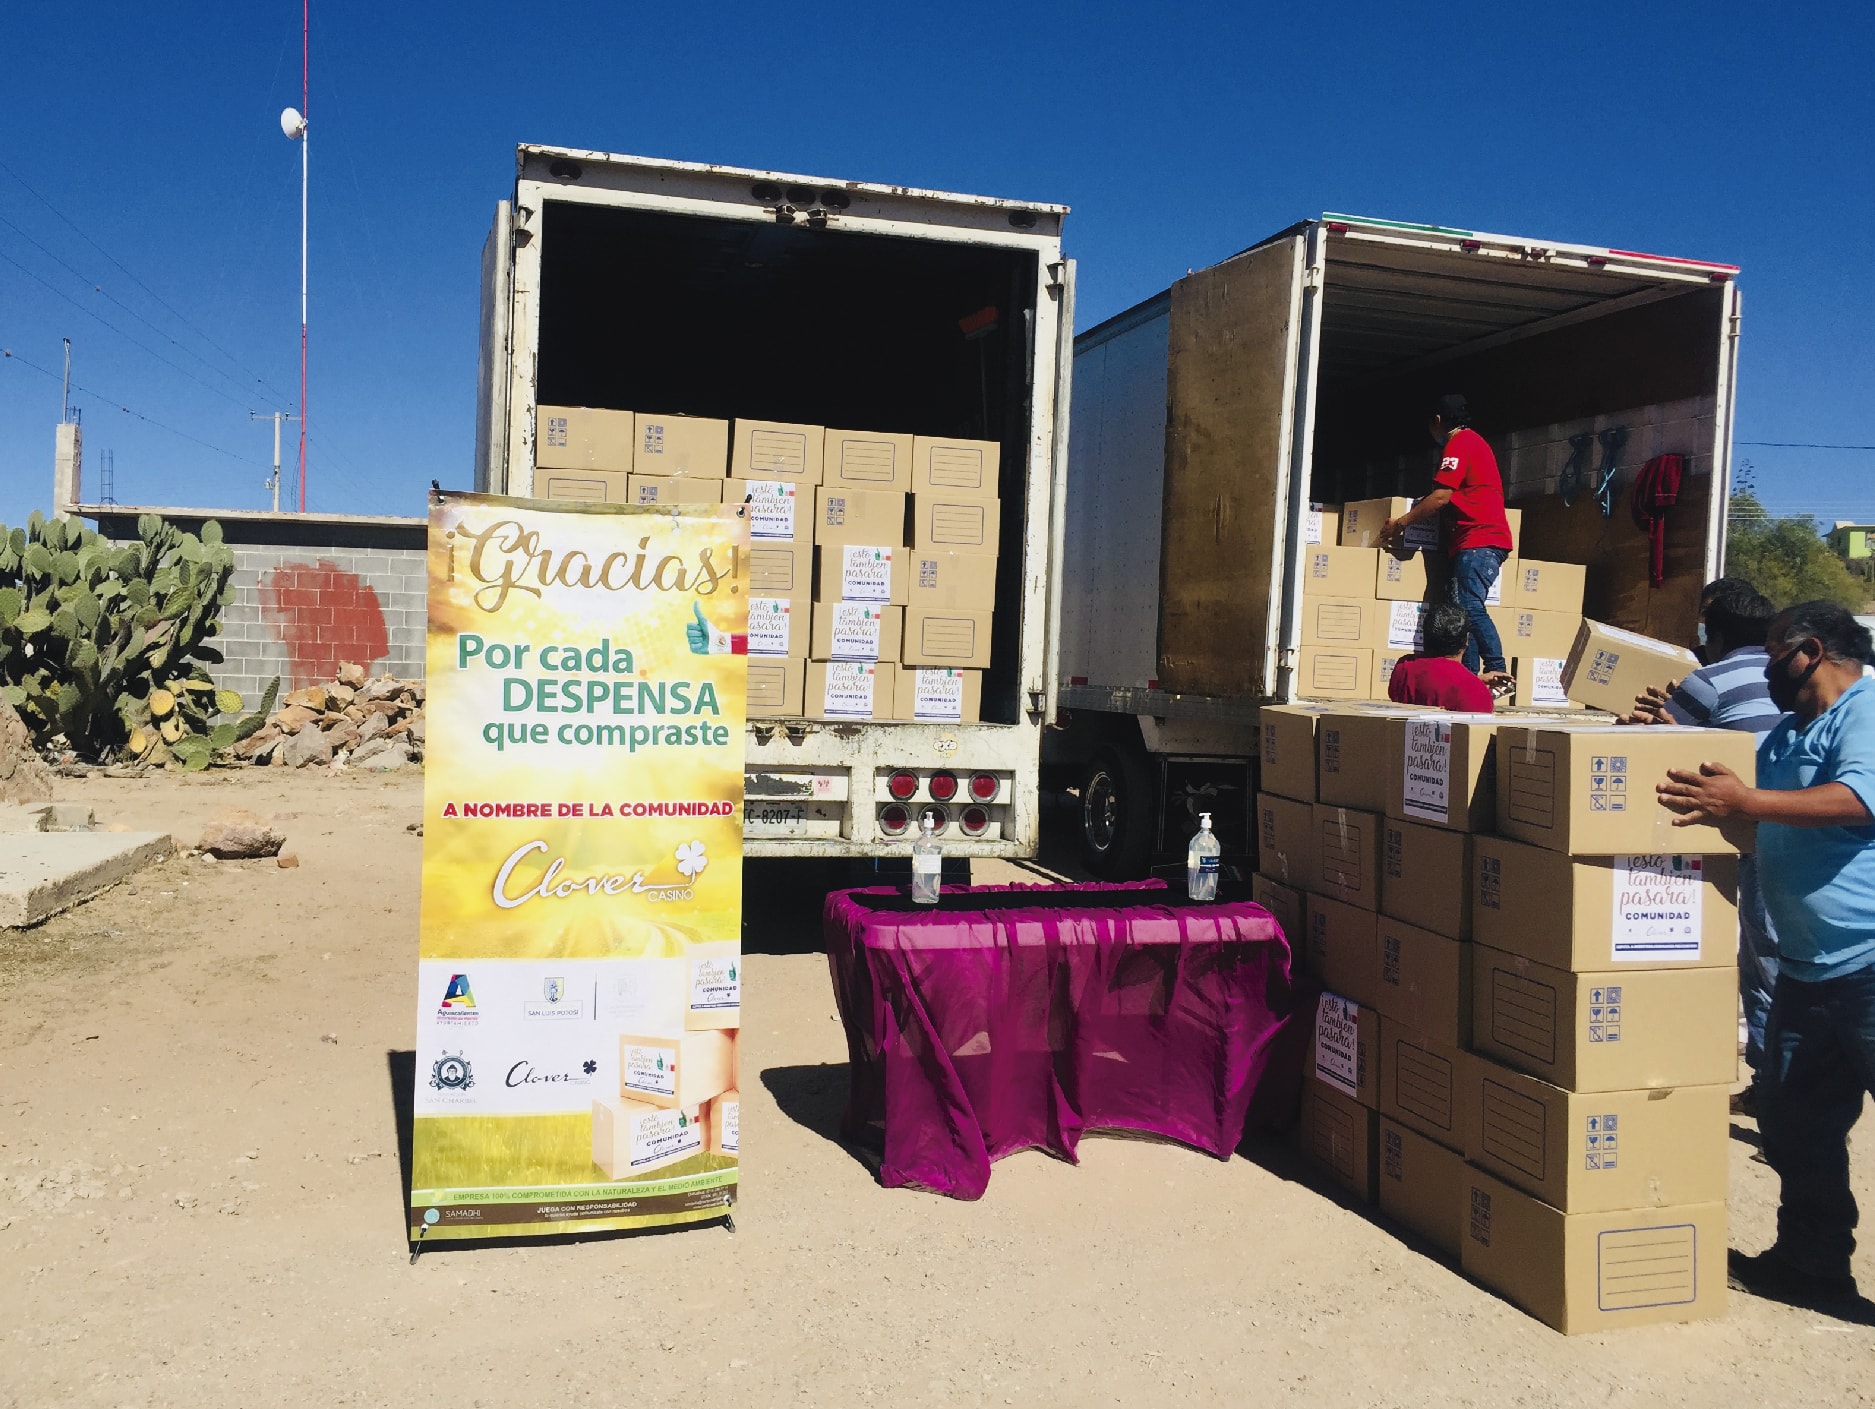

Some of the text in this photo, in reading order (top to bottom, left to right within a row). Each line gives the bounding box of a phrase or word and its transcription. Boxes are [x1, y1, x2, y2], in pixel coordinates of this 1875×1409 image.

[1440, 457, 1459, 469] 23
[447, 520, 739, 613] ¡Gracias!
[458, 634, 634, 674] Por cada
[503, 678, 720, 716] DESPENSA
[483, 721, 729, 753] que compraste
[1410, 773, 1443, 786] COMUNIDAD
[443, 801, 733, 818] A NOMBRE DE LA COMUNIDAD
[493, 840, 647, 909] Clover
[648, 888, 694, 902] CASINO
[1625, 912, 1690, 920] COMUNIDAD
[1321, 1042, 1351, 1061] COMUNIDAD
[505, 1060, 569, 1088] Clover
[646, 1130, 689, 1146] COMUNIDAD
[512, 1191, 571, 1199] COMPROMETIDA
[603, 1187, 650, 1195] NATURALEZA
[669, 1182, 690, 1190] MEDIO
[690, 1176, 723, 1187] AMBIENTE
[446, 1209, 481, 1217] SAMADHI
[577, 1202, 637, 1211] RESPONSABILIDAD
